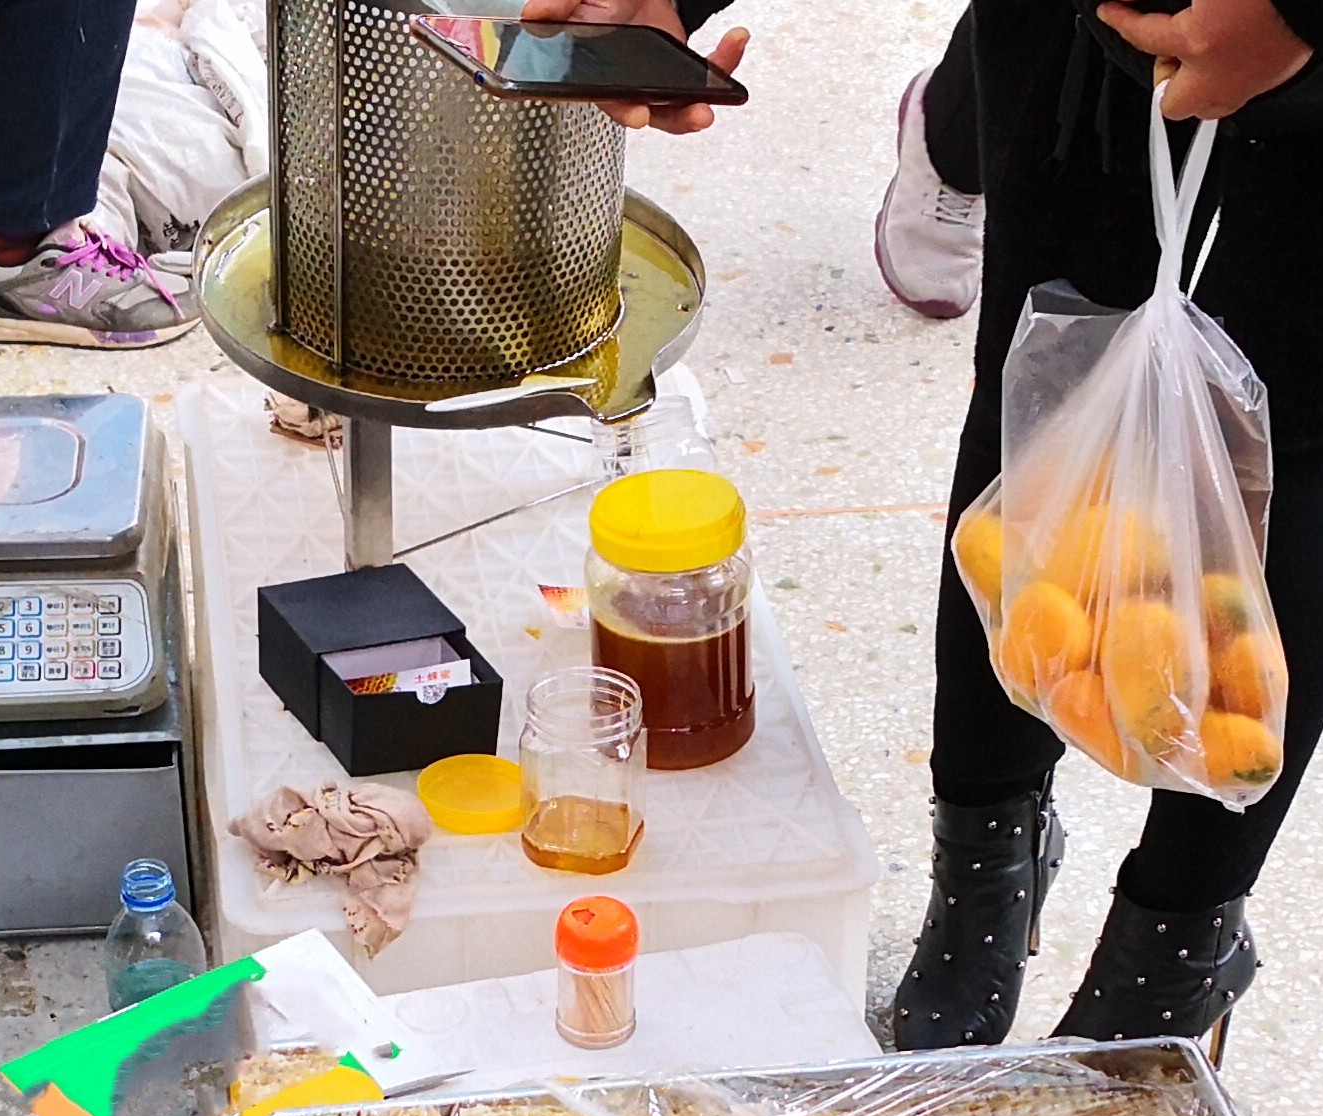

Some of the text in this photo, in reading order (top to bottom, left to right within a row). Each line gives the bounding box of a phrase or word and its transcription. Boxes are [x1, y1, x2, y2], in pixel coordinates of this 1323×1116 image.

[49, 268, 103, 310] N
[25, 601, 33, 611] 3
[25, 623, 33, 633] 6
[25, 645, 33, 655] 9
